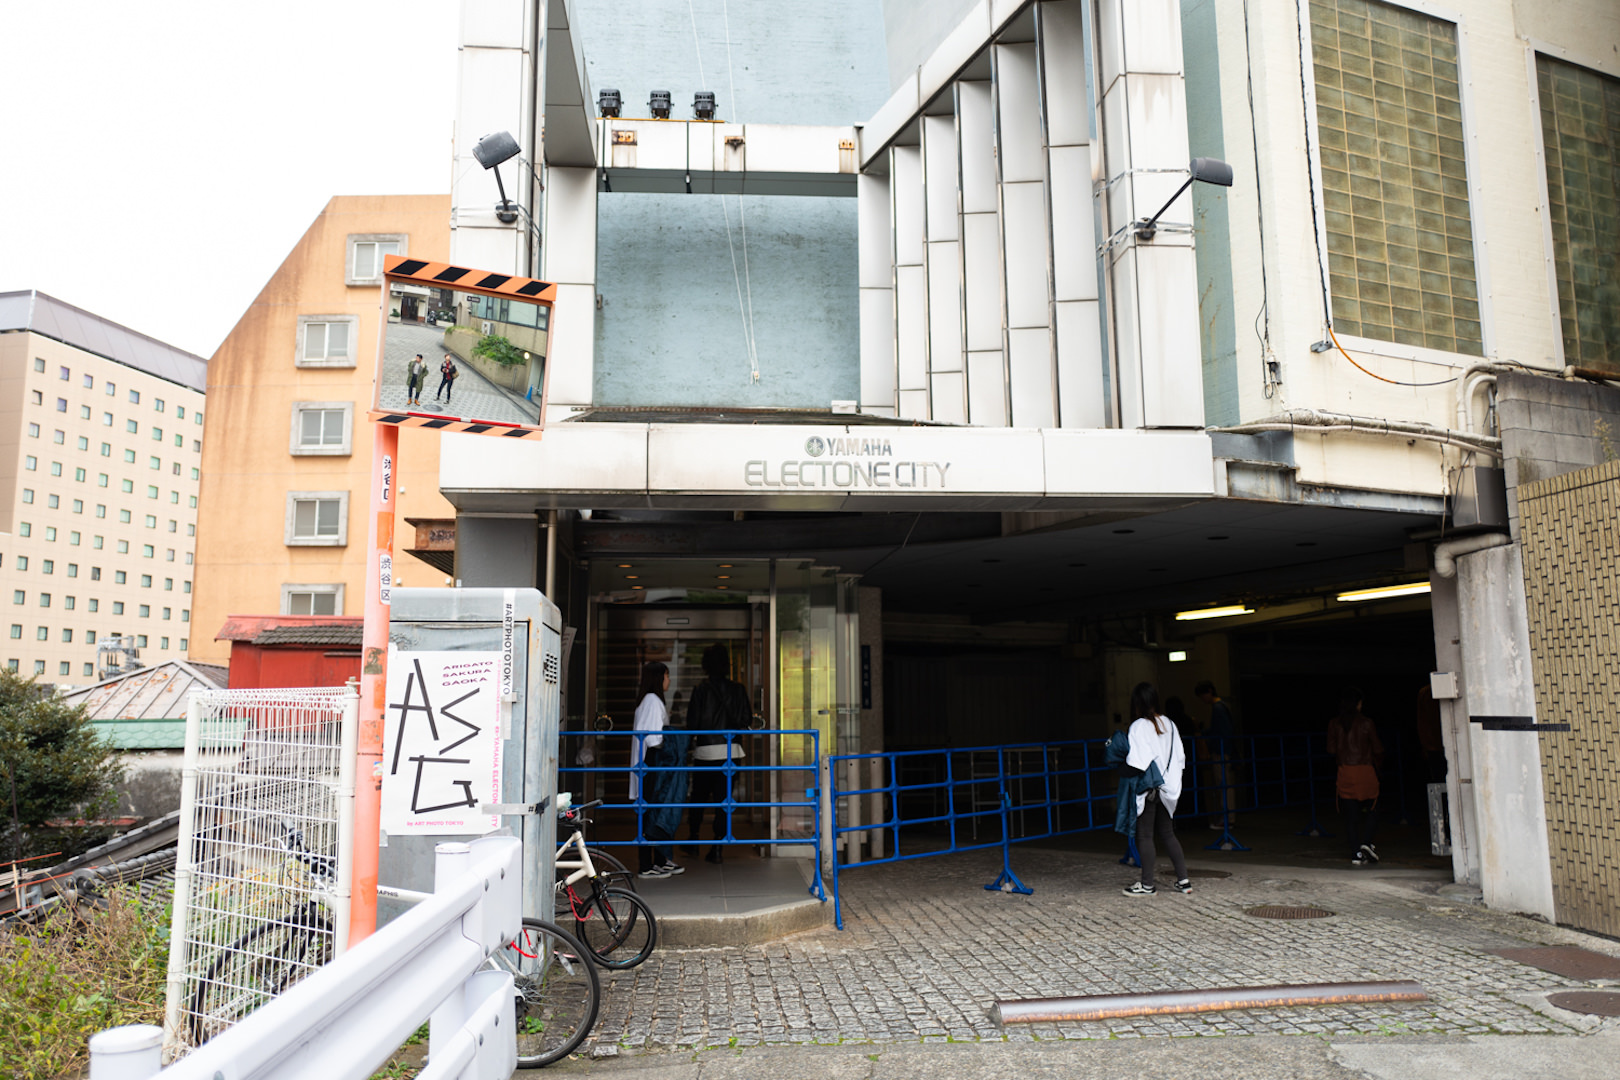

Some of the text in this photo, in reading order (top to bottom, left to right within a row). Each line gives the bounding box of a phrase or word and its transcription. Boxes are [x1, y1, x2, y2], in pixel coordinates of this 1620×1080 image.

[826, 438, 892, 456] YAMAHA
[744, 460, 951, 487] ELECTONE CITY
[503, 603, 513, 695] #ARTPHOTOTOKYO
[443, 661, 493, 670] ARIGATO
[442, 668, 491, 678] SAKURA
[442, 677, 487, 686] GAOKA
